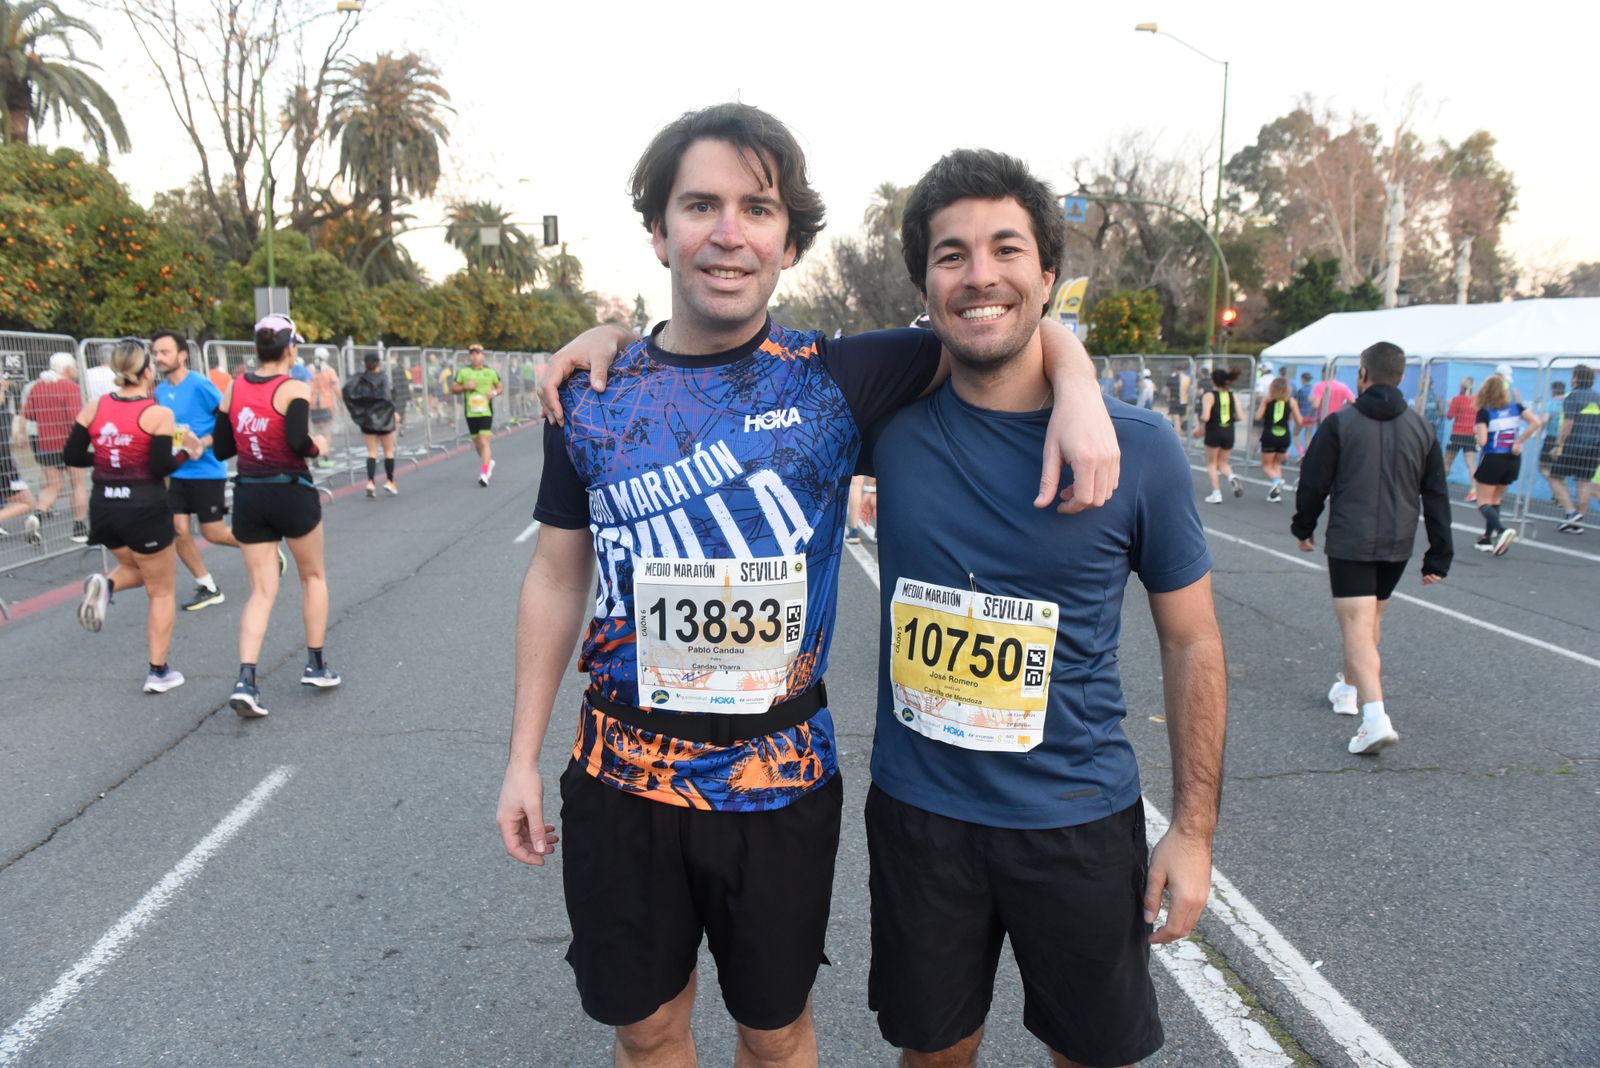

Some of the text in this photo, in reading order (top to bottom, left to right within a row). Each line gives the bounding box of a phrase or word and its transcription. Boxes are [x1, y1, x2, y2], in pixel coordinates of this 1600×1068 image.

[743, 407, 802, 433] HOKA
[608, 439, 744, 522] MARATÓN
[644, 560, 788, 582] MEDIO MARATÓN SEVILLA
[901, 582, 1034, 622] MEDIO MARATÓN SEVILLA
[649, 597, 783, 645] 13833
[687, 646, 745, 655] Pablo Candau
[904, 617, 1024, 683] 10750
[691, 663, 742, 671] Candau Ybarra
[929, 670, 947, 682] José
[948, 675, 980, 689] Romero
[710, 696, 736, 705] HOKA
[944, 691, 954, 700] de
[953, 694, 983, 706] Mendoza
[942, 724, 966, 739] HOKA
